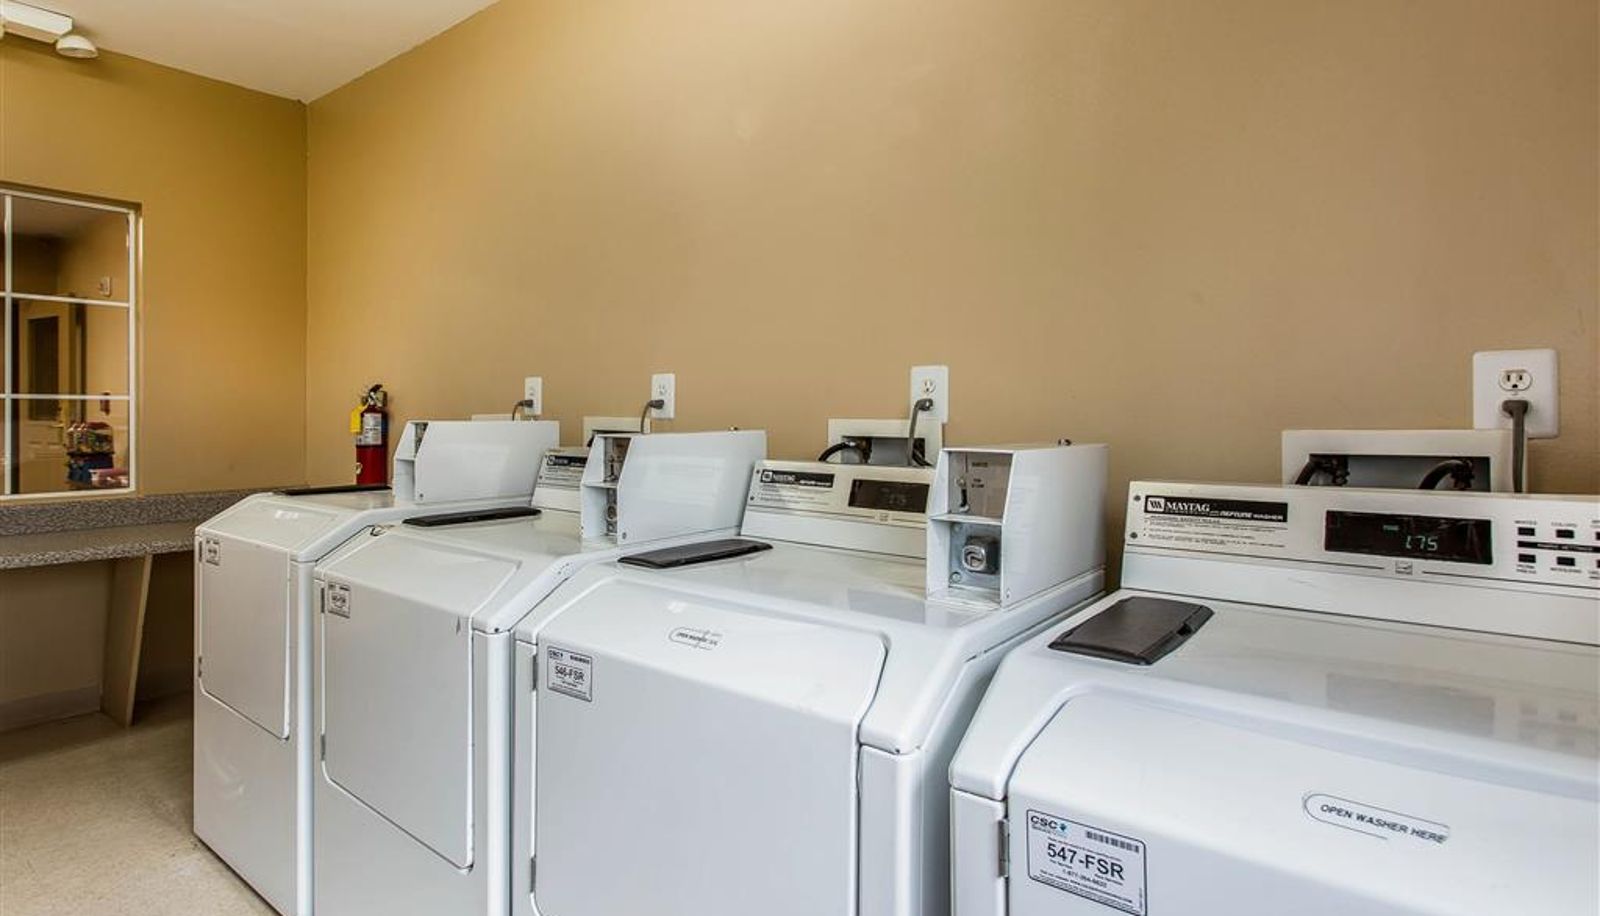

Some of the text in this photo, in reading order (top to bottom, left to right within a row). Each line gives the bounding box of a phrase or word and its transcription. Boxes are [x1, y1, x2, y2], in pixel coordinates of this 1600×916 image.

[1166, 501, 1210, 512] MAYTAG
[1030, 815, 1058, 830] CSC
[1320, 804, 1448, 844] OPEN WASHER HERE
[1047, 842, 1125, 881] 547-FSR
